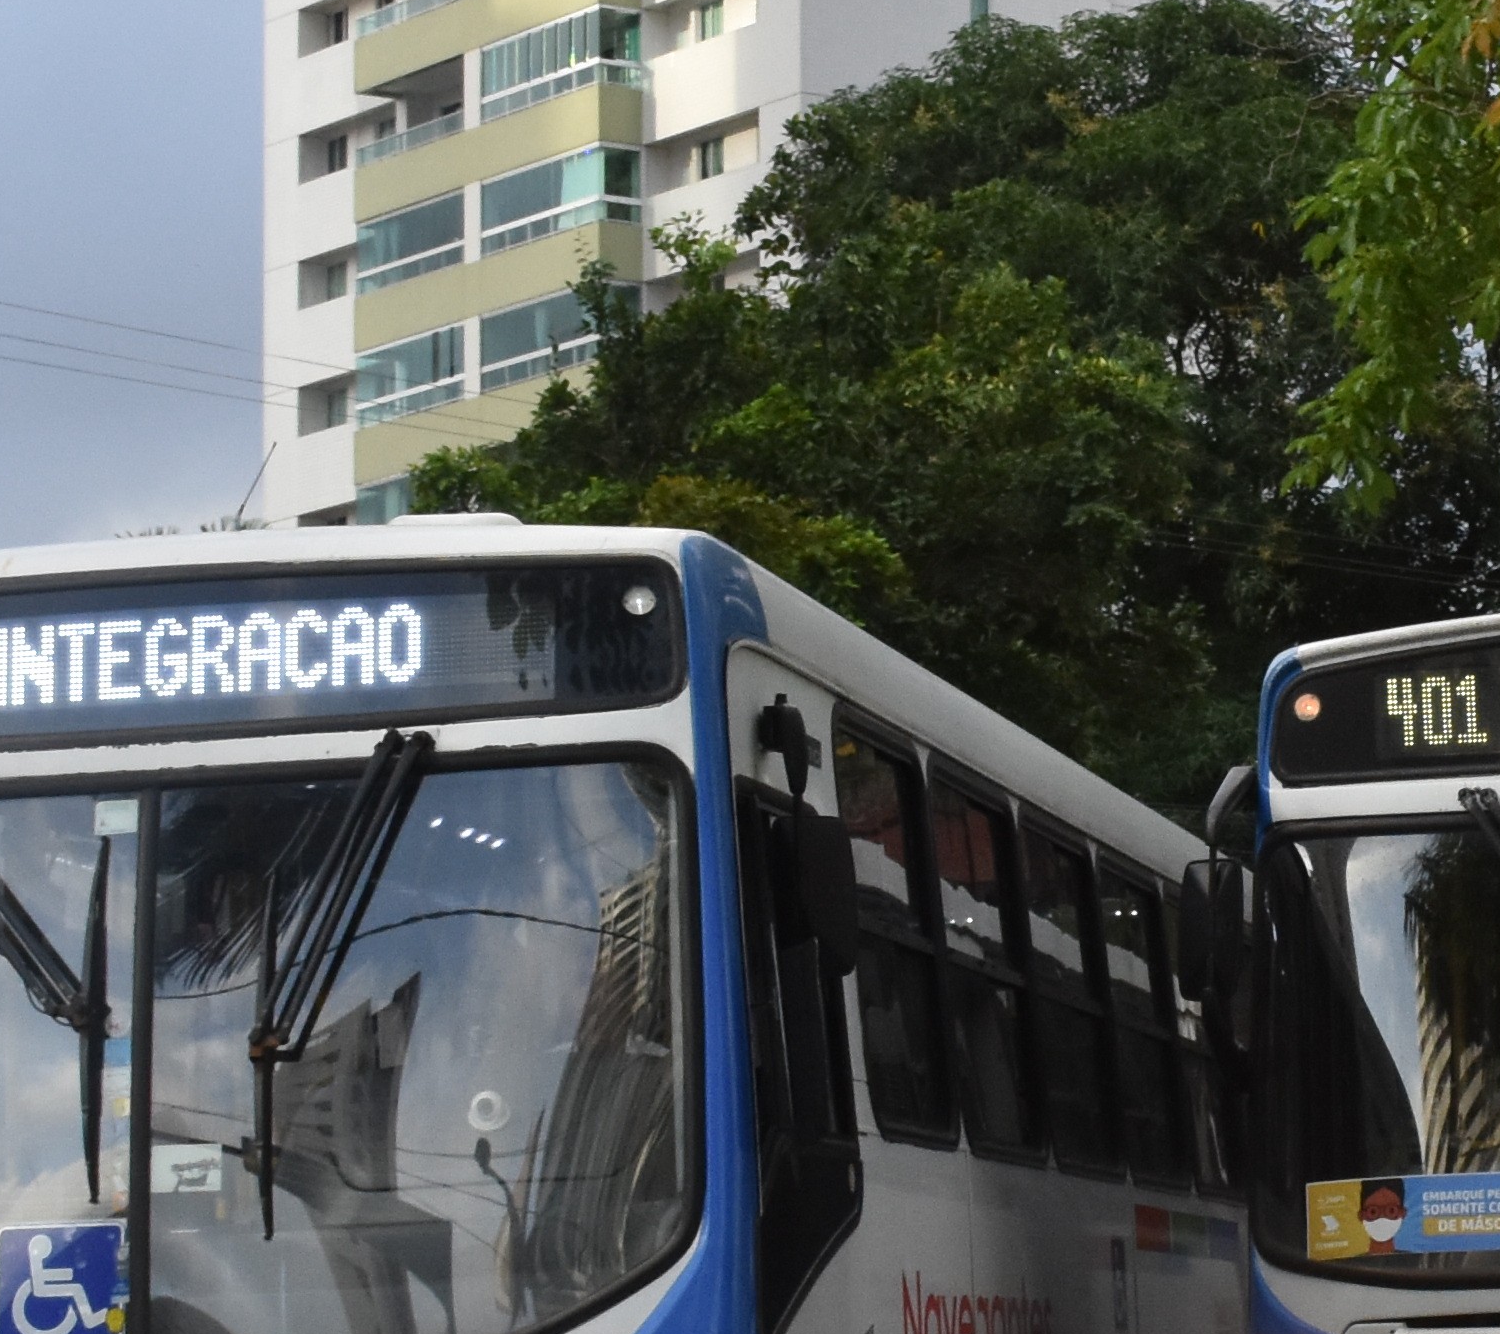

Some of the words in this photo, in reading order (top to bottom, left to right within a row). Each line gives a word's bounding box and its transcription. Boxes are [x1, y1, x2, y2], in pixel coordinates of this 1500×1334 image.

[1386, 673, 1489, 747] 401
[1422, 1189, 1485, 1202] EMBARQUE
[1422, 1202, 1486, 1216] SOMENTE
[1438, 1219, 1457, 1233] DE
